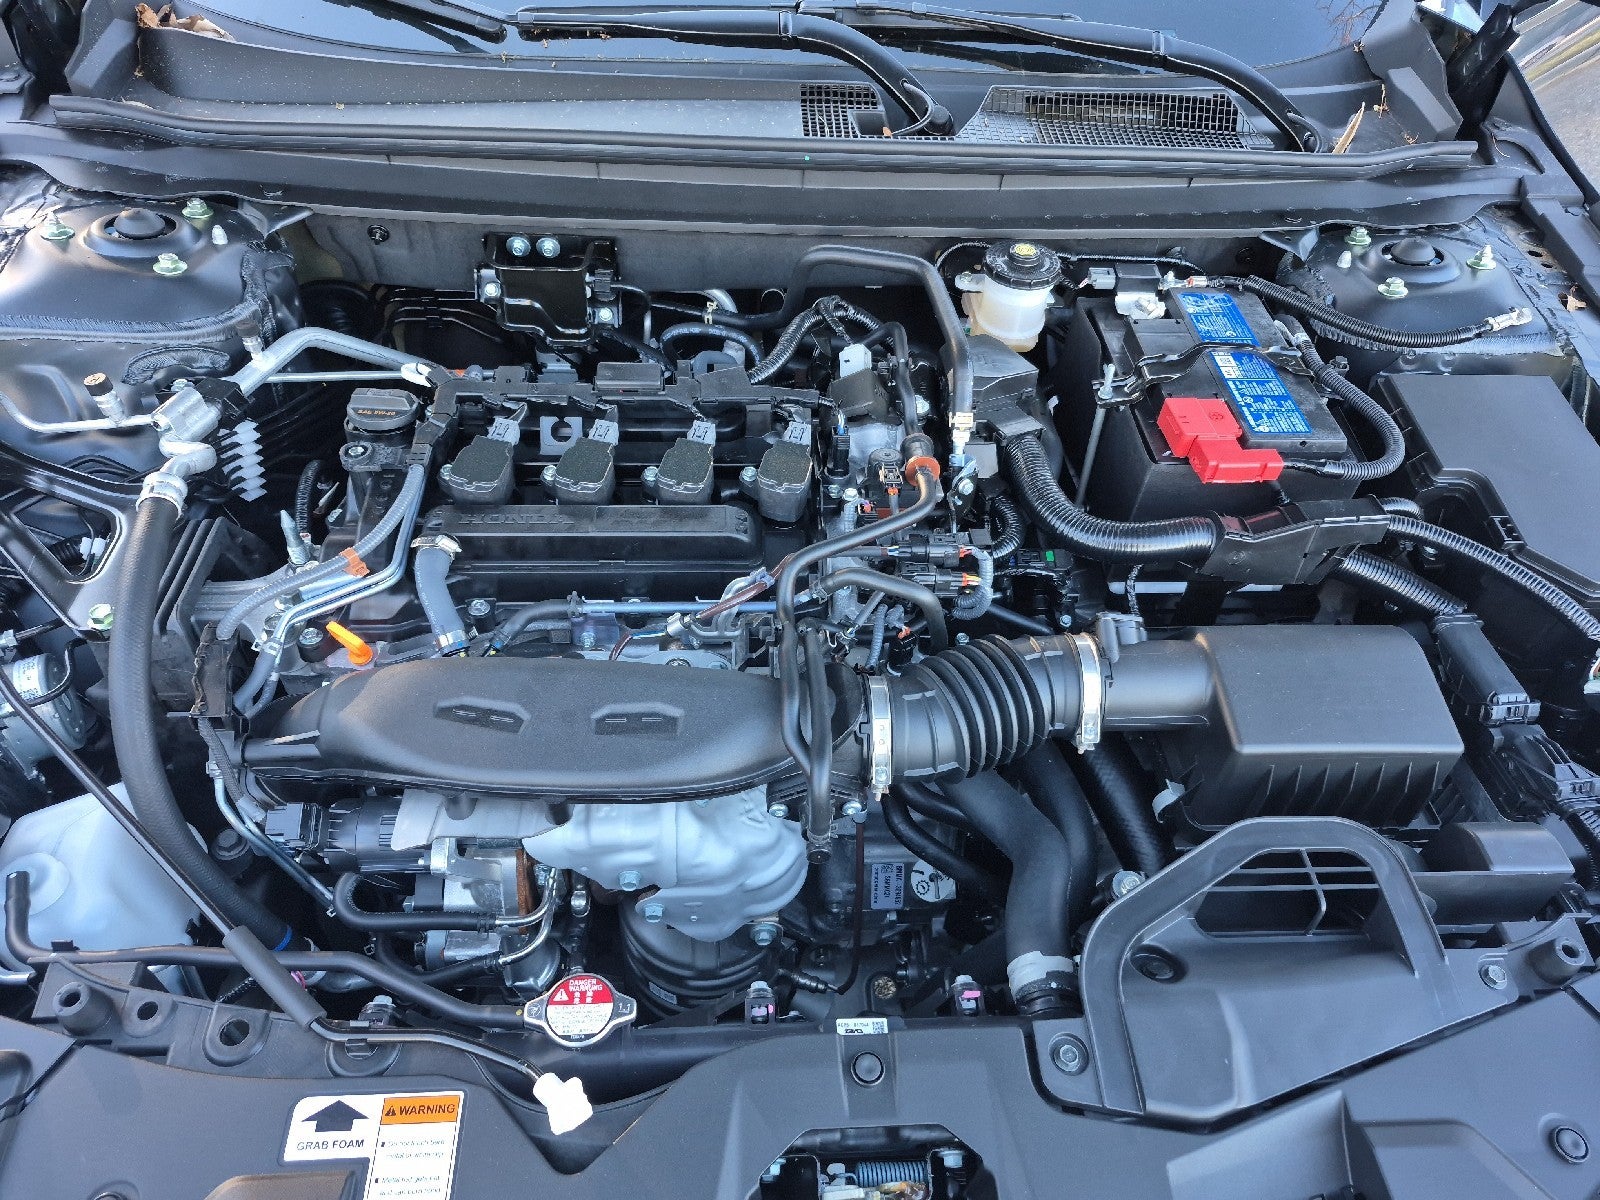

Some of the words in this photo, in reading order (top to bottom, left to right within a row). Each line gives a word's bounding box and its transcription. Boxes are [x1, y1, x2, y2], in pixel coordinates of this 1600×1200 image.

[458, 514, 575, 525] HONDA
[399, 1103, 456, 1116] WARNING
[296, 1140, 329, 1151] GRAB
[332, 1138, 365, 1149] FOAM
